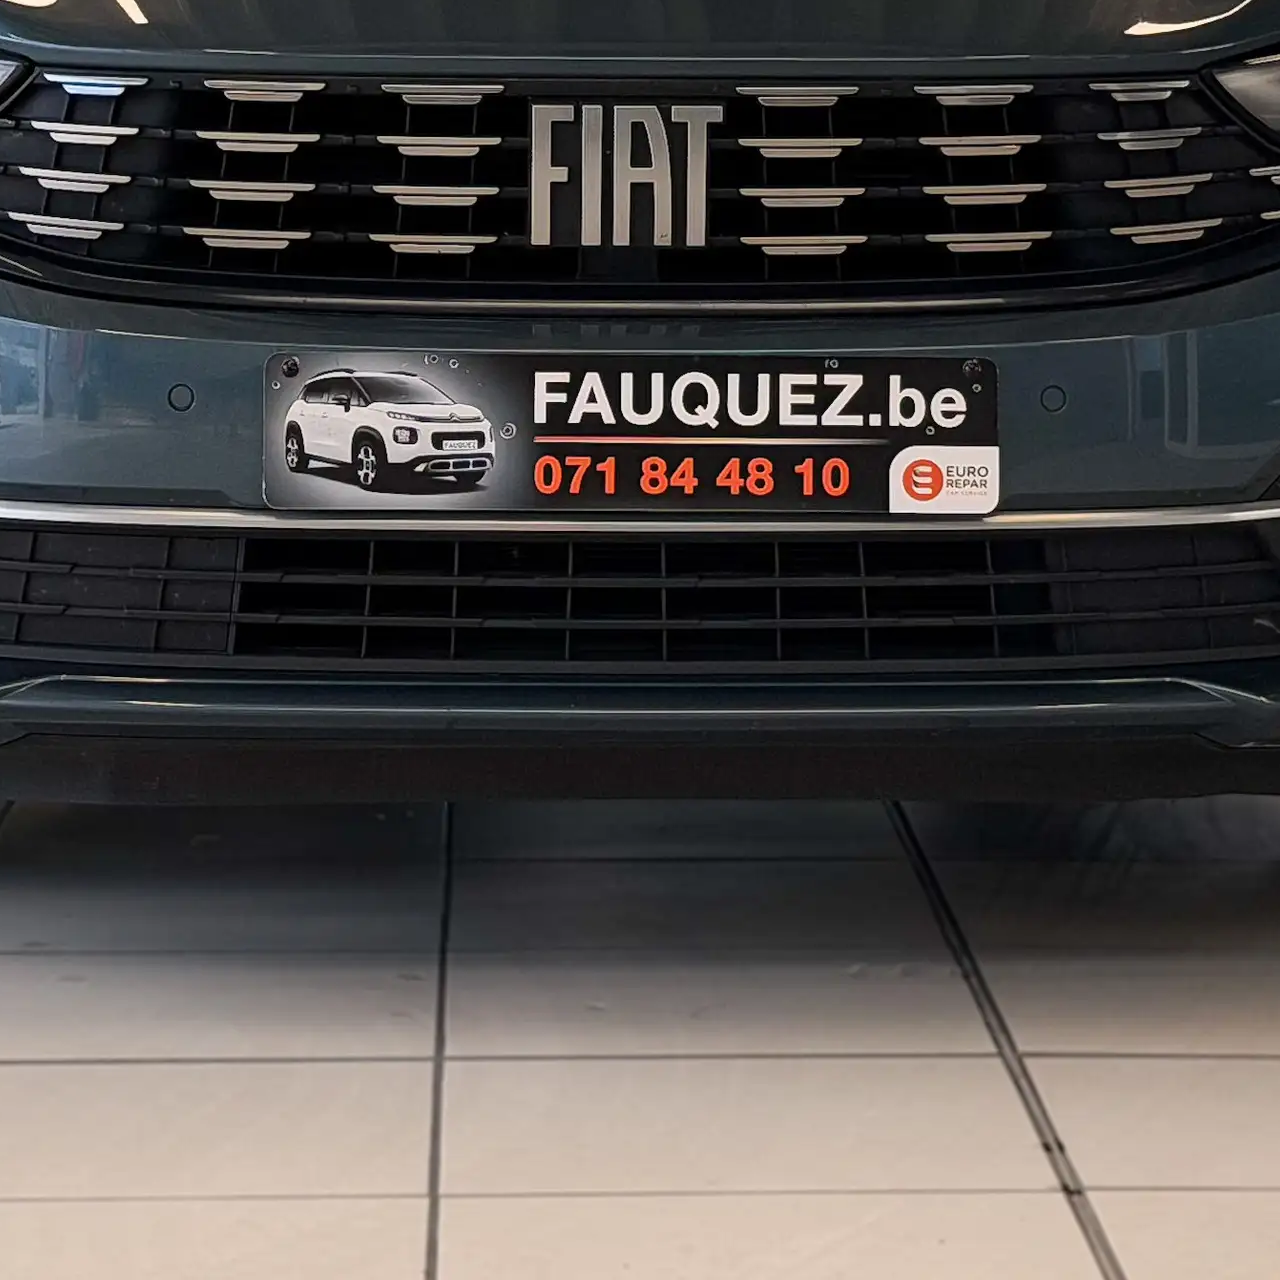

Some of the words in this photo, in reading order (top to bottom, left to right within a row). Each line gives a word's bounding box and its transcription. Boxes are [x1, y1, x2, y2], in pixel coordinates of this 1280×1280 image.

[530, 104, 724, 247] FIAT
[533, 370, 968, 429] FAUQUEZ.be
[533, 454, 616, 495] 071
[639, 456, 698, 495] 84
[715, 457, 774, 496] 48
[793, 457, 850, 497] 10
[946, 465, 989, 478] EURO
[946, 478, 988, 489] REPAR
